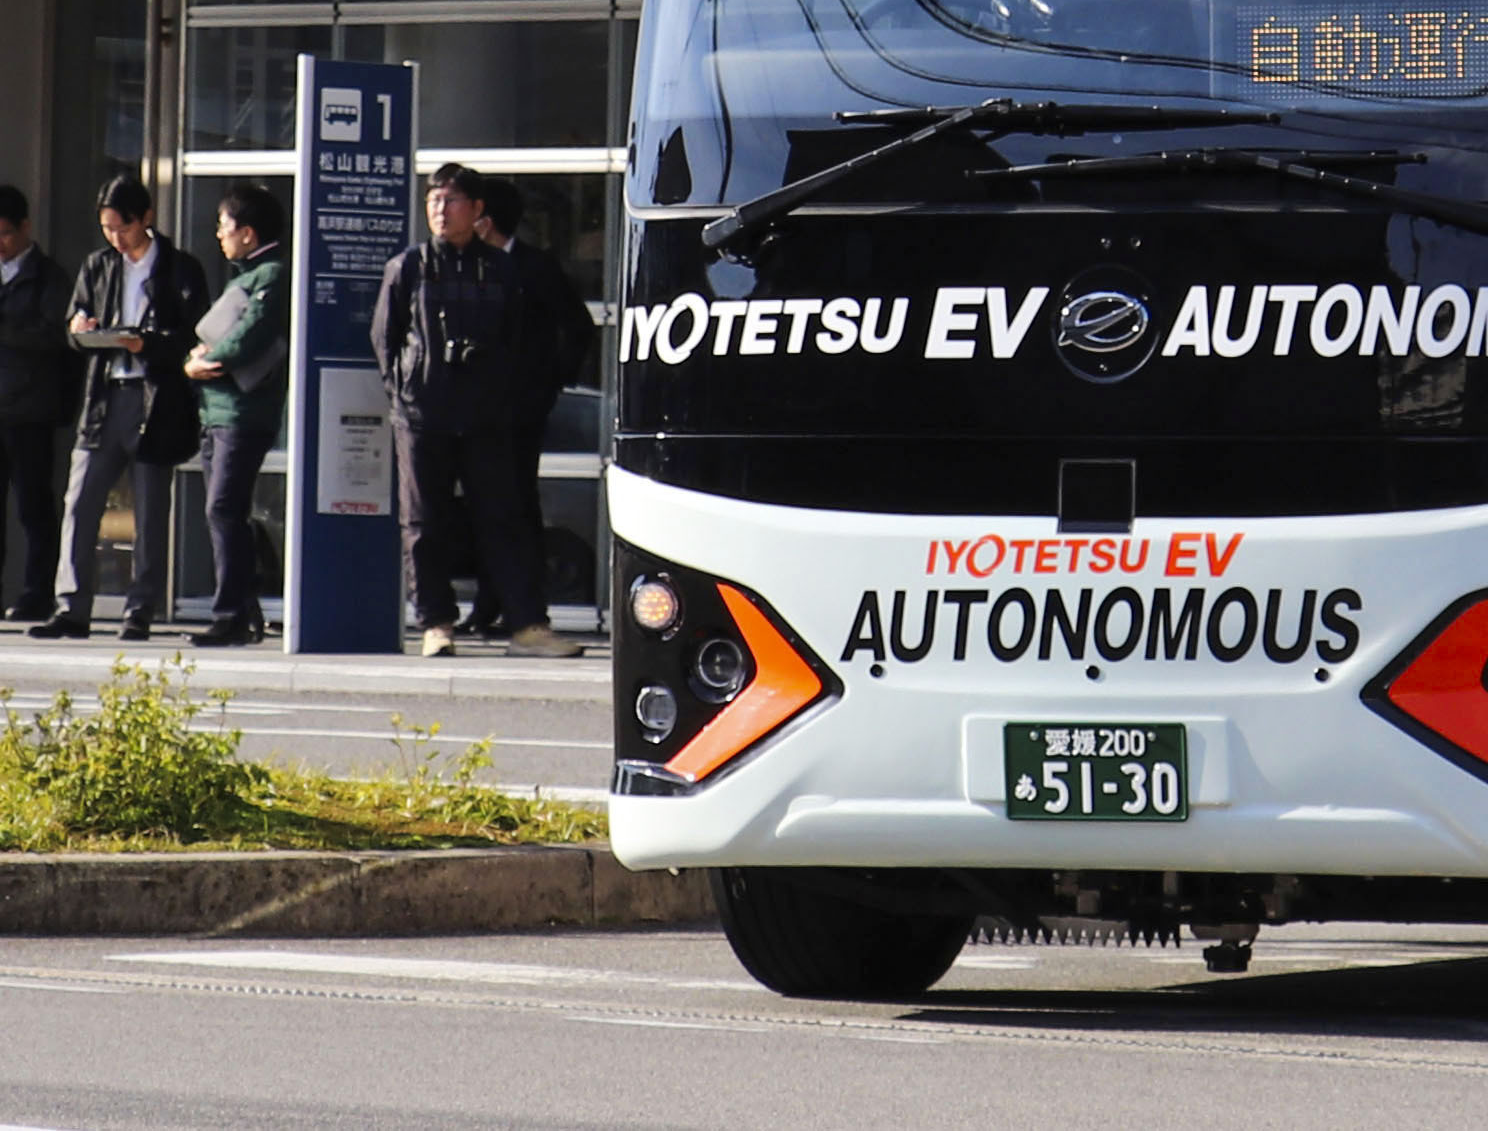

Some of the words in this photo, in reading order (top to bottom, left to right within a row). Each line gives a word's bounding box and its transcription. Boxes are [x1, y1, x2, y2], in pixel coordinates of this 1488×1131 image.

[376, 93, 392, 141] 1
[619, 292, 909, 364] IYOTETSU
[924, 286, 1051, 359] EV
[925, 533, 1150, 578] IYOTETSU
[1163, 532, 1245, 577] EV
[839, 586, 1363, 663] AUTONOMOUS
[1014, 773, 1037, 802] あ
[1042, 761, 1178, 815] 51-30
